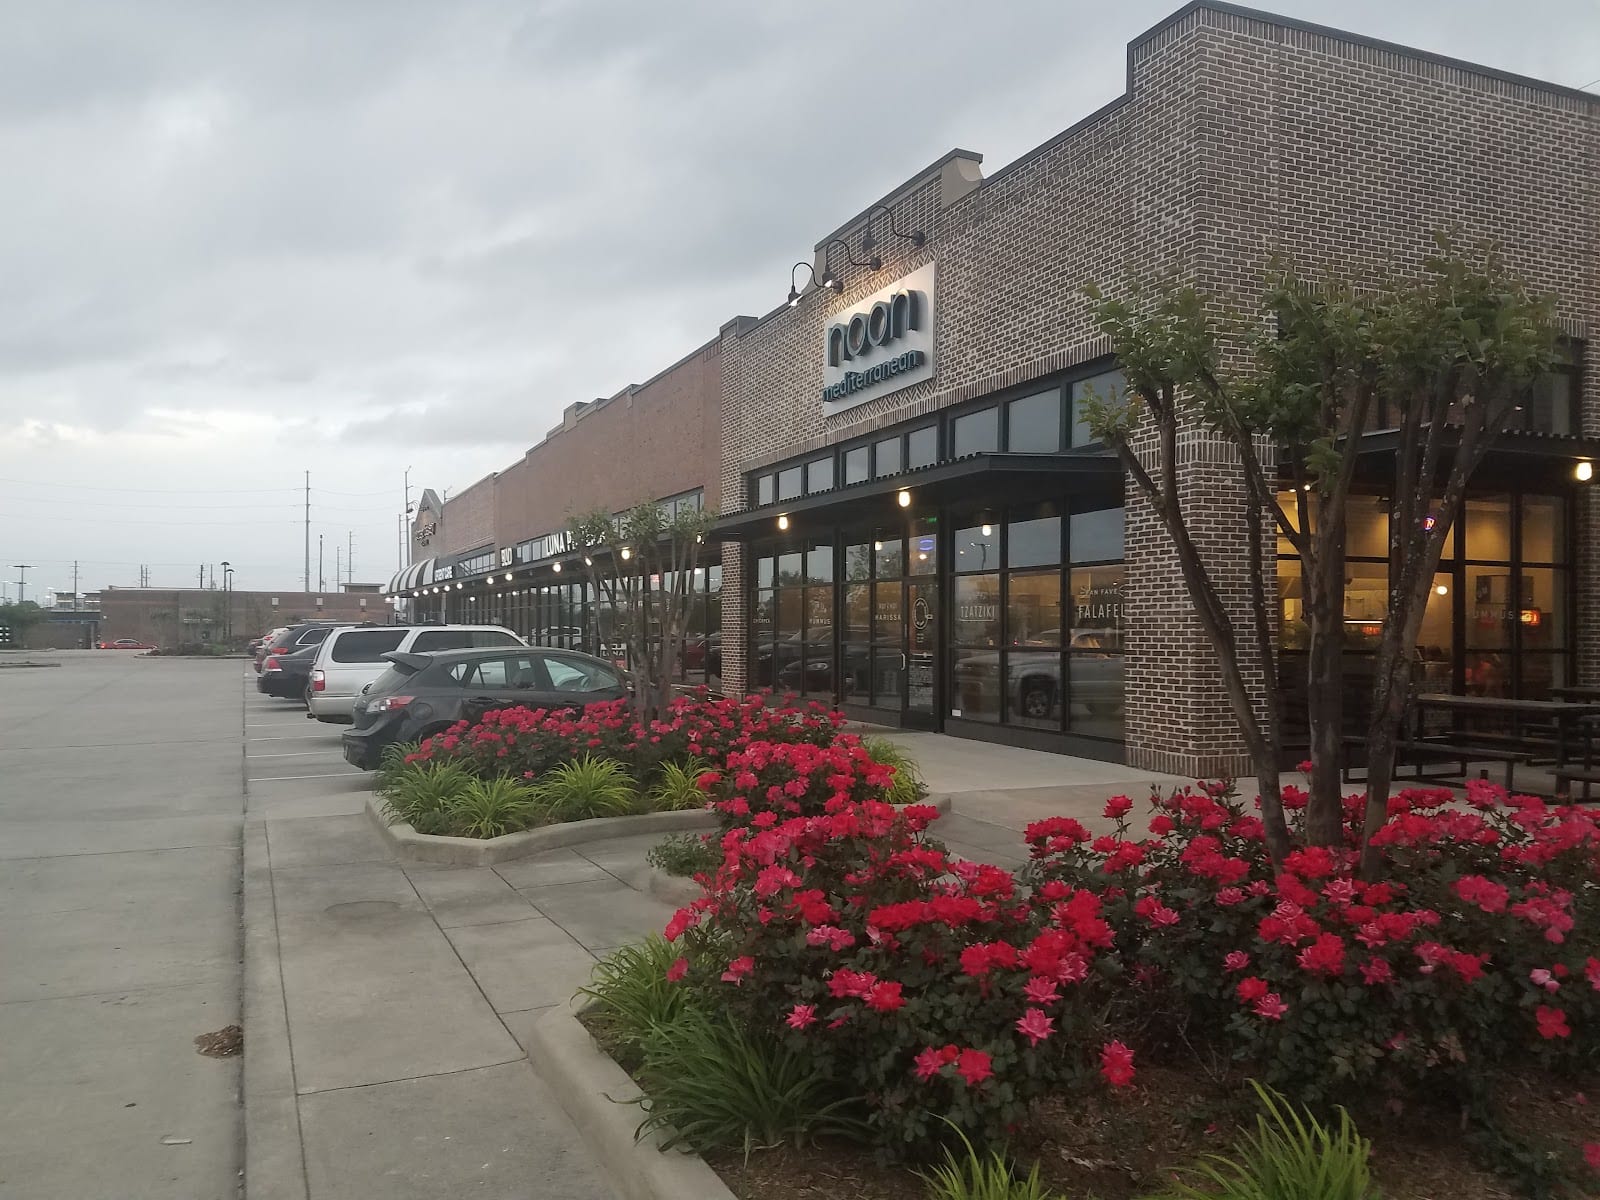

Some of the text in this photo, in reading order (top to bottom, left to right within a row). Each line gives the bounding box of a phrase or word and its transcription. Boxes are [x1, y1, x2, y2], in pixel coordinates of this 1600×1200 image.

[827, 288, 918, 367] noon
[823, 350, 924, 402] mediterranean
[545, 532, 566, 556] LUNA
[1100, 588, 1119, 596] FAVE
[960, 605, 996, 620] TZATZIKI
[1078, 603, 1126, 619] FALAFEL
